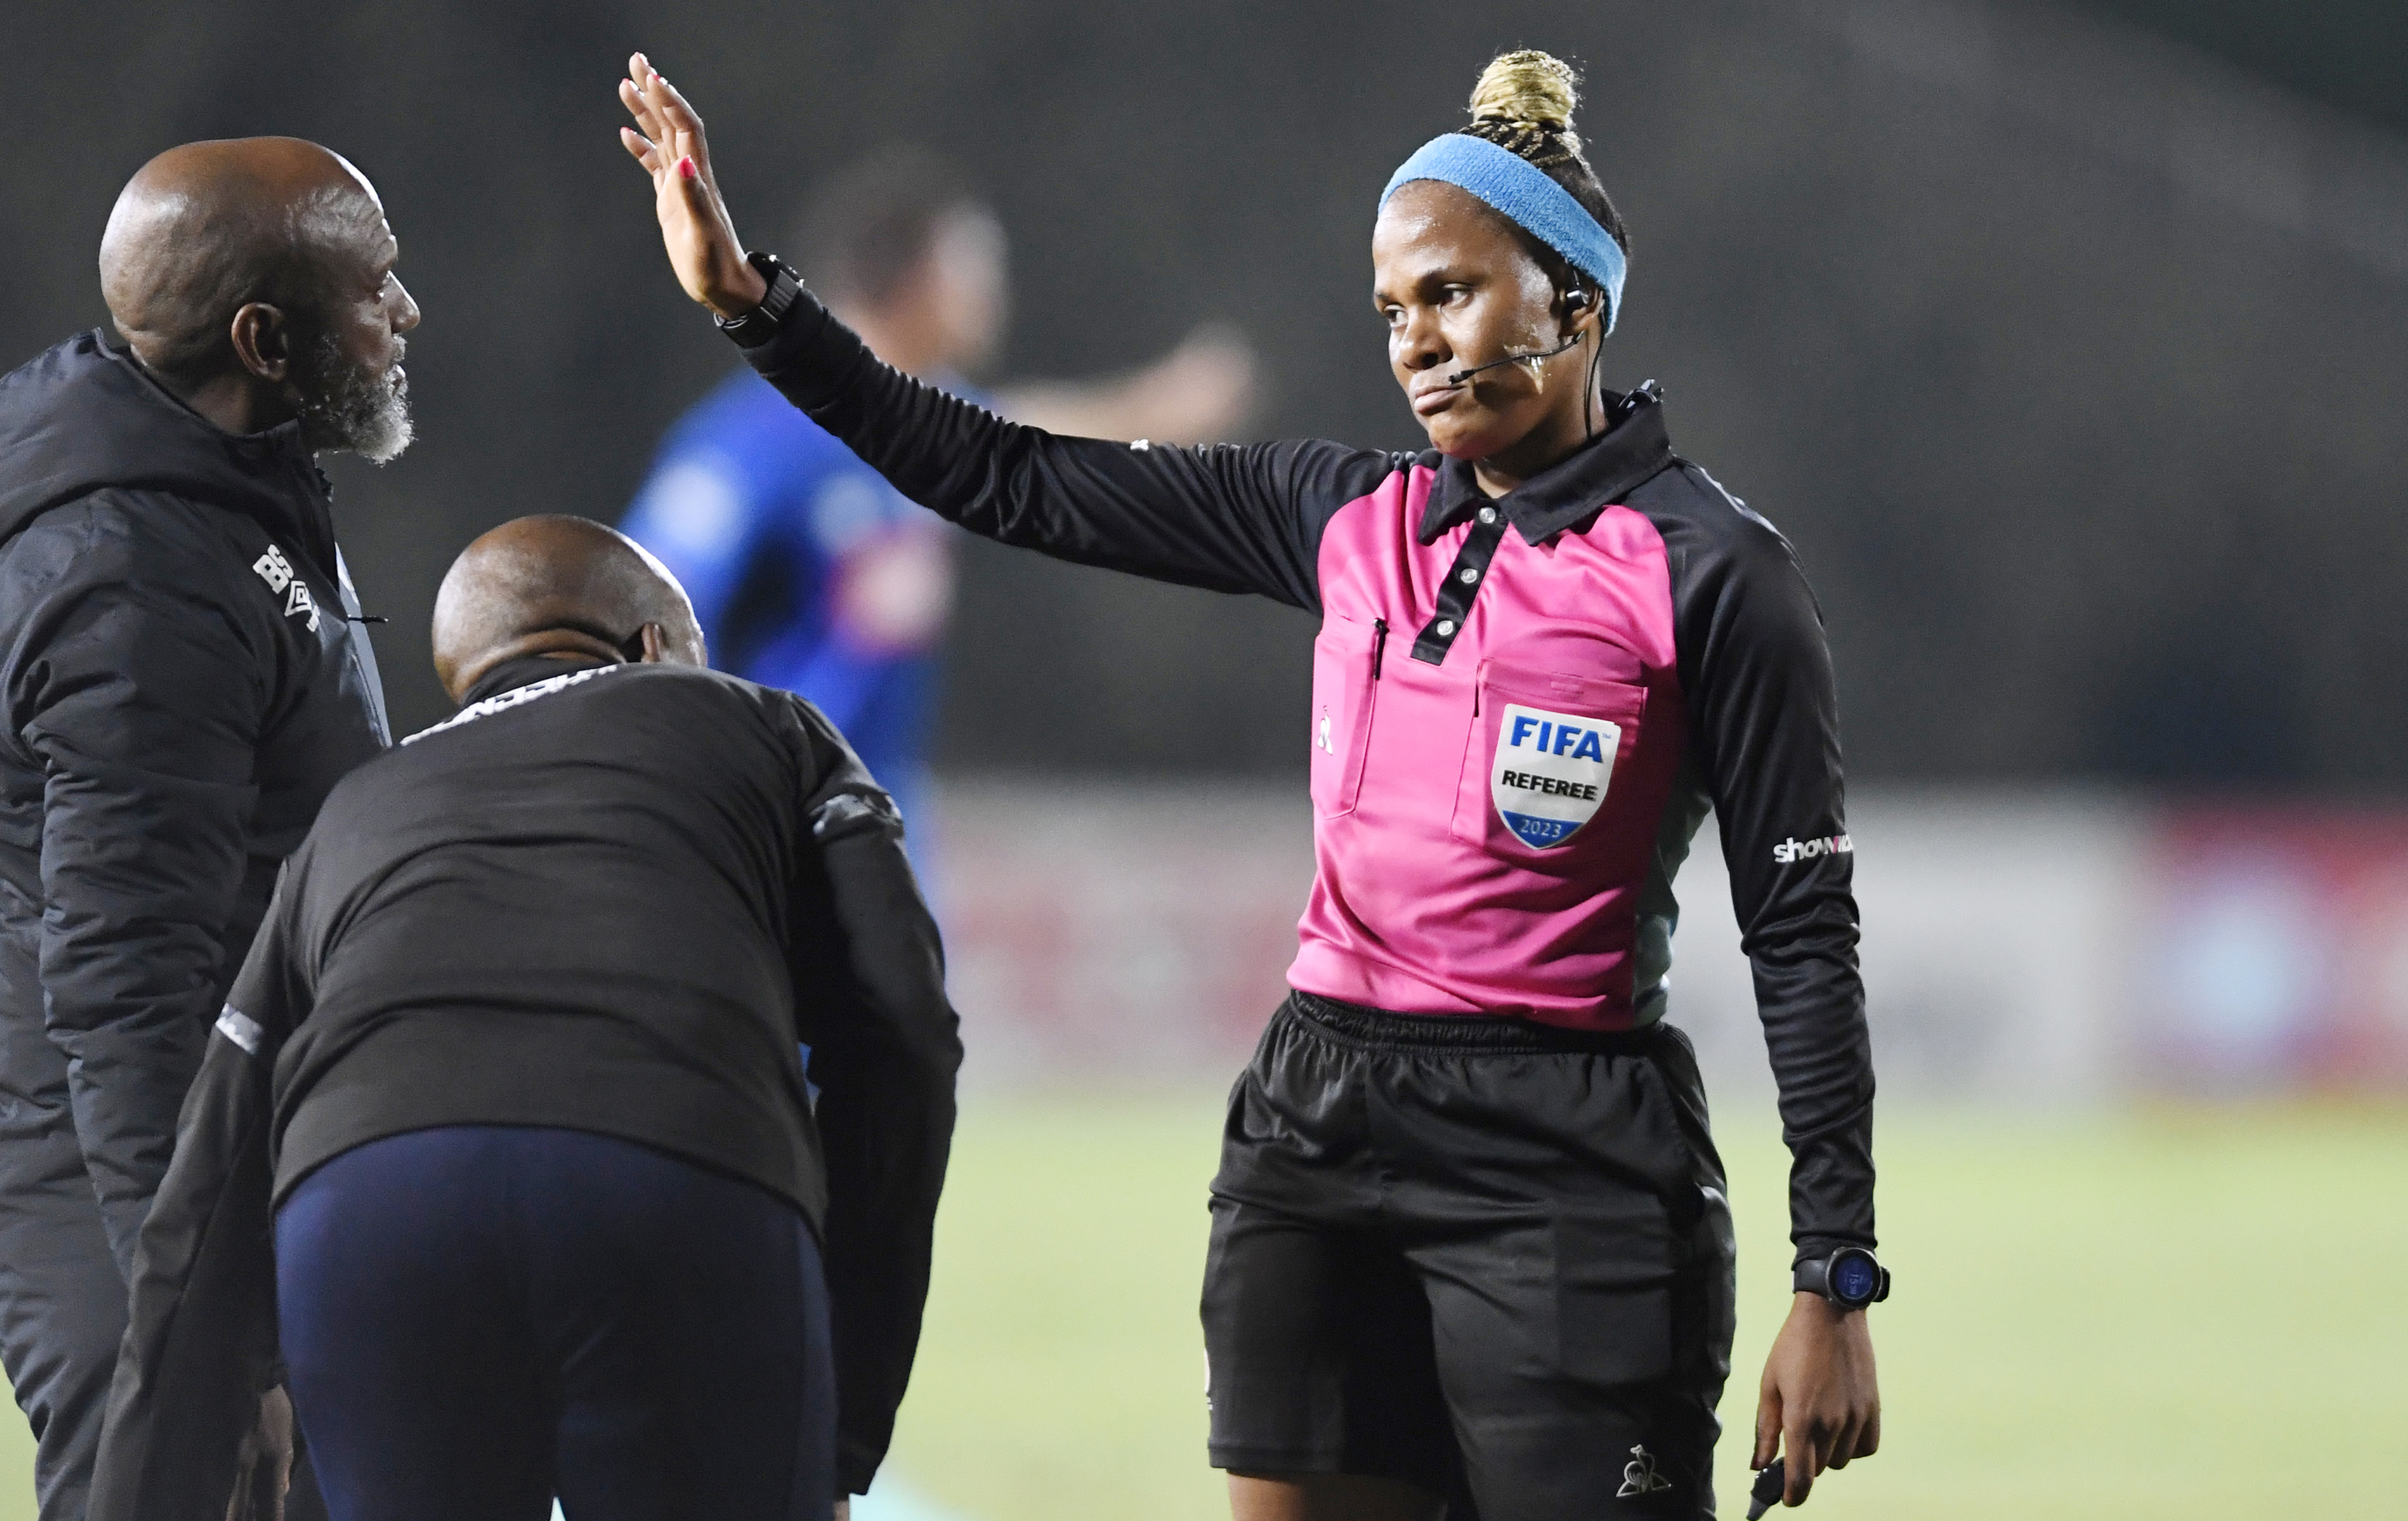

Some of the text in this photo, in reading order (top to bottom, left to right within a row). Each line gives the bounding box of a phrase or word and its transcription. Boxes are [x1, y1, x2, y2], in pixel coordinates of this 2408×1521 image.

[253, 544, 294, 594] BS
[1511, 715, 1603, 763] FIFA
[1502, 770, 1598, 801] REFEREE
[1521, 819, 1562, 838] 2023
